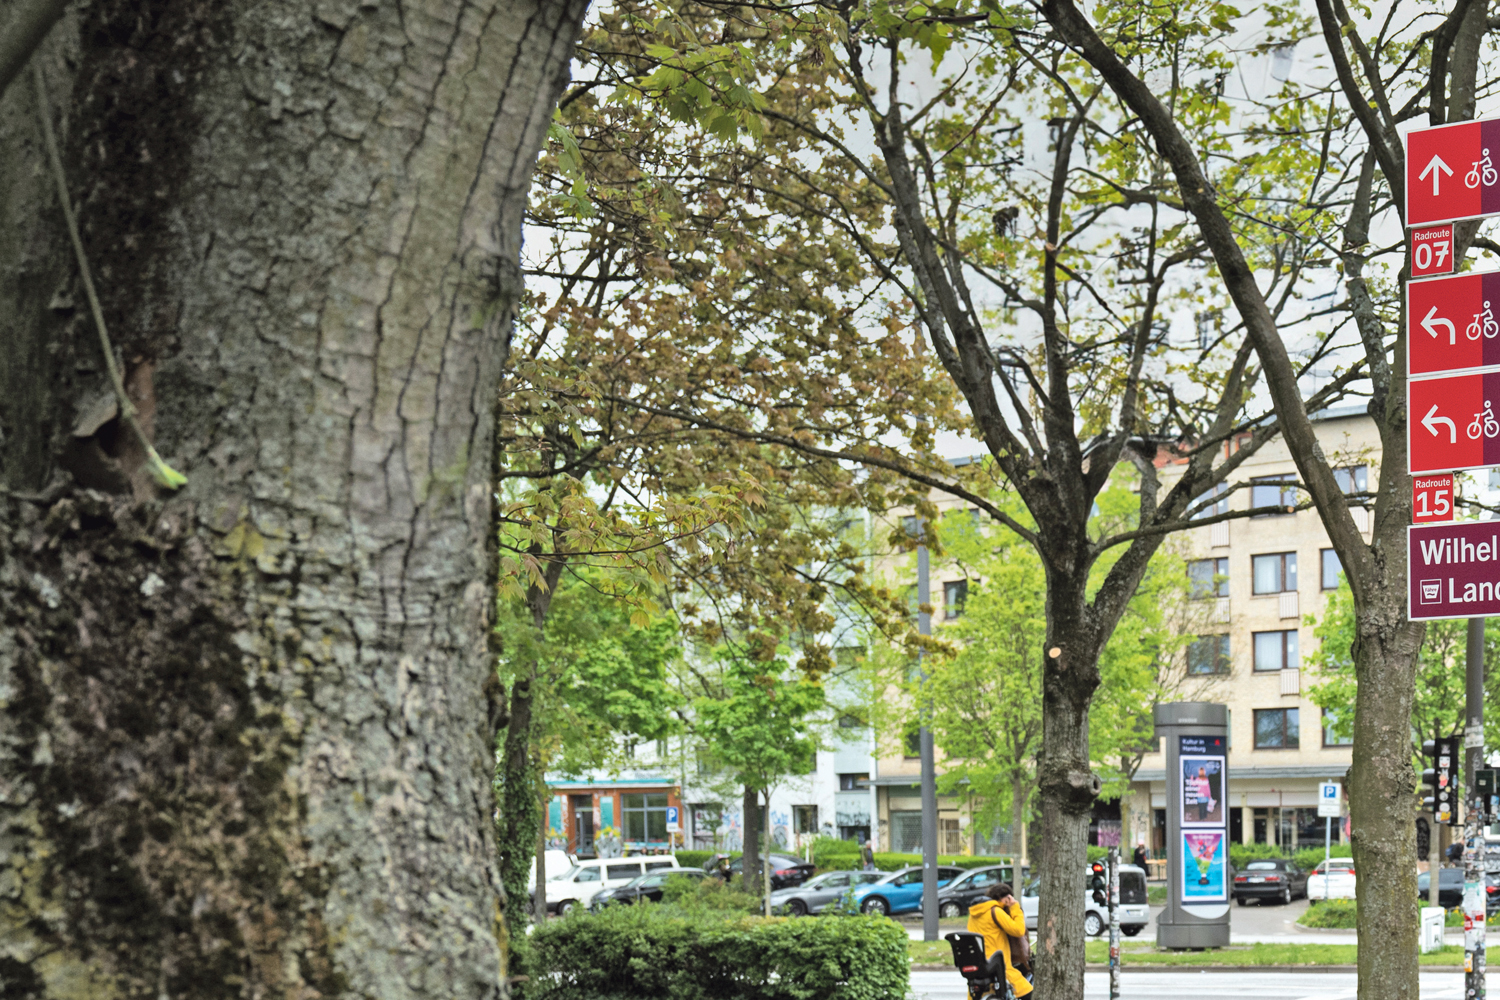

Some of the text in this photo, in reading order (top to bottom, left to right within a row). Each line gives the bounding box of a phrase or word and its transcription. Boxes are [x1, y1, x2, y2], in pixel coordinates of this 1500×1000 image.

[1415, 230, 1449, 241] Radroute
[1415, 243, 1449, 269] 07
[1416, 479, 1450, 488] Radroute
[1417, 490, 1449, 517] 15
[1326, 787, 1334, 797] P
[669, 808, 676, 821] P
